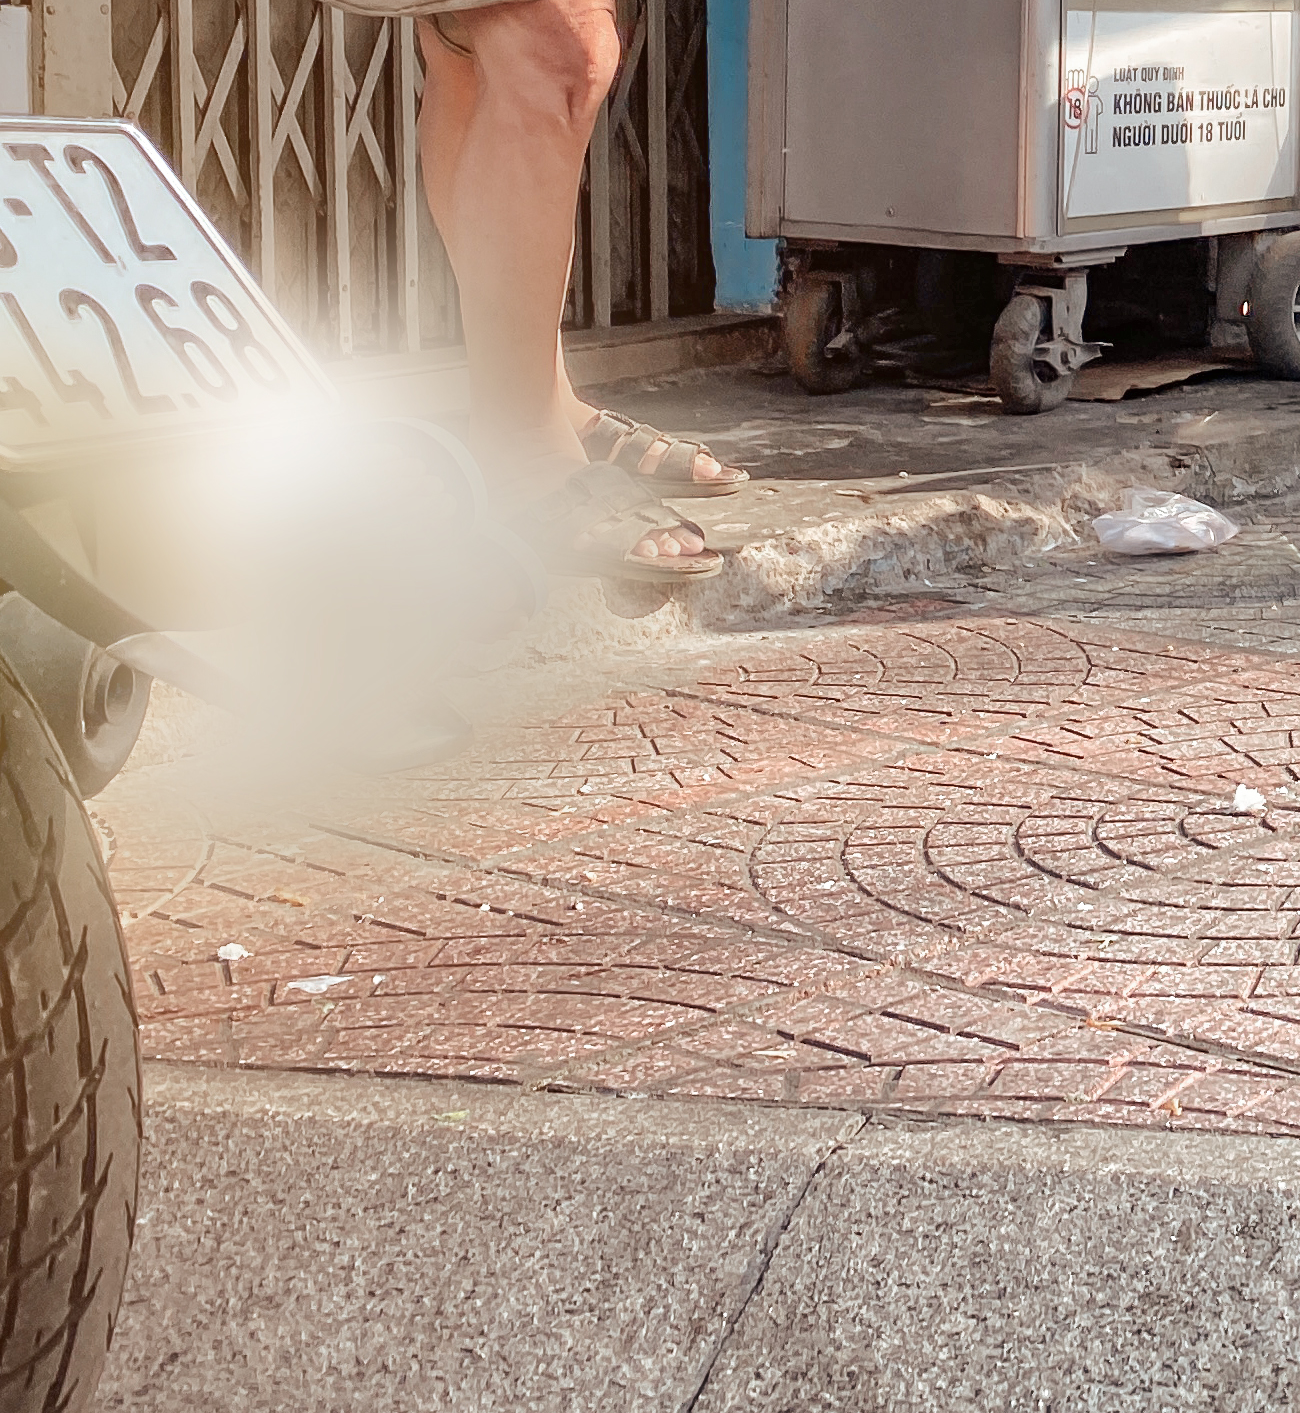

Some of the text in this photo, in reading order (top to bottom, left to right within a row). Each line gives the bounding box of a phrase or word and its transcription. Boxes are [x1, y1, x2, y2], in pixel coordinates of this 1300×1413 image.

[1113, 64, 1139, 85] LUẬT
[1140, 66, 1160, 84] QUY
[1112, 83, 1286, 115] KHÔNG BÁN THUỐC LÁ CHO
[1112, 111, 1246, 148] NGƯỜI DƯỚI 18 TUỔI
